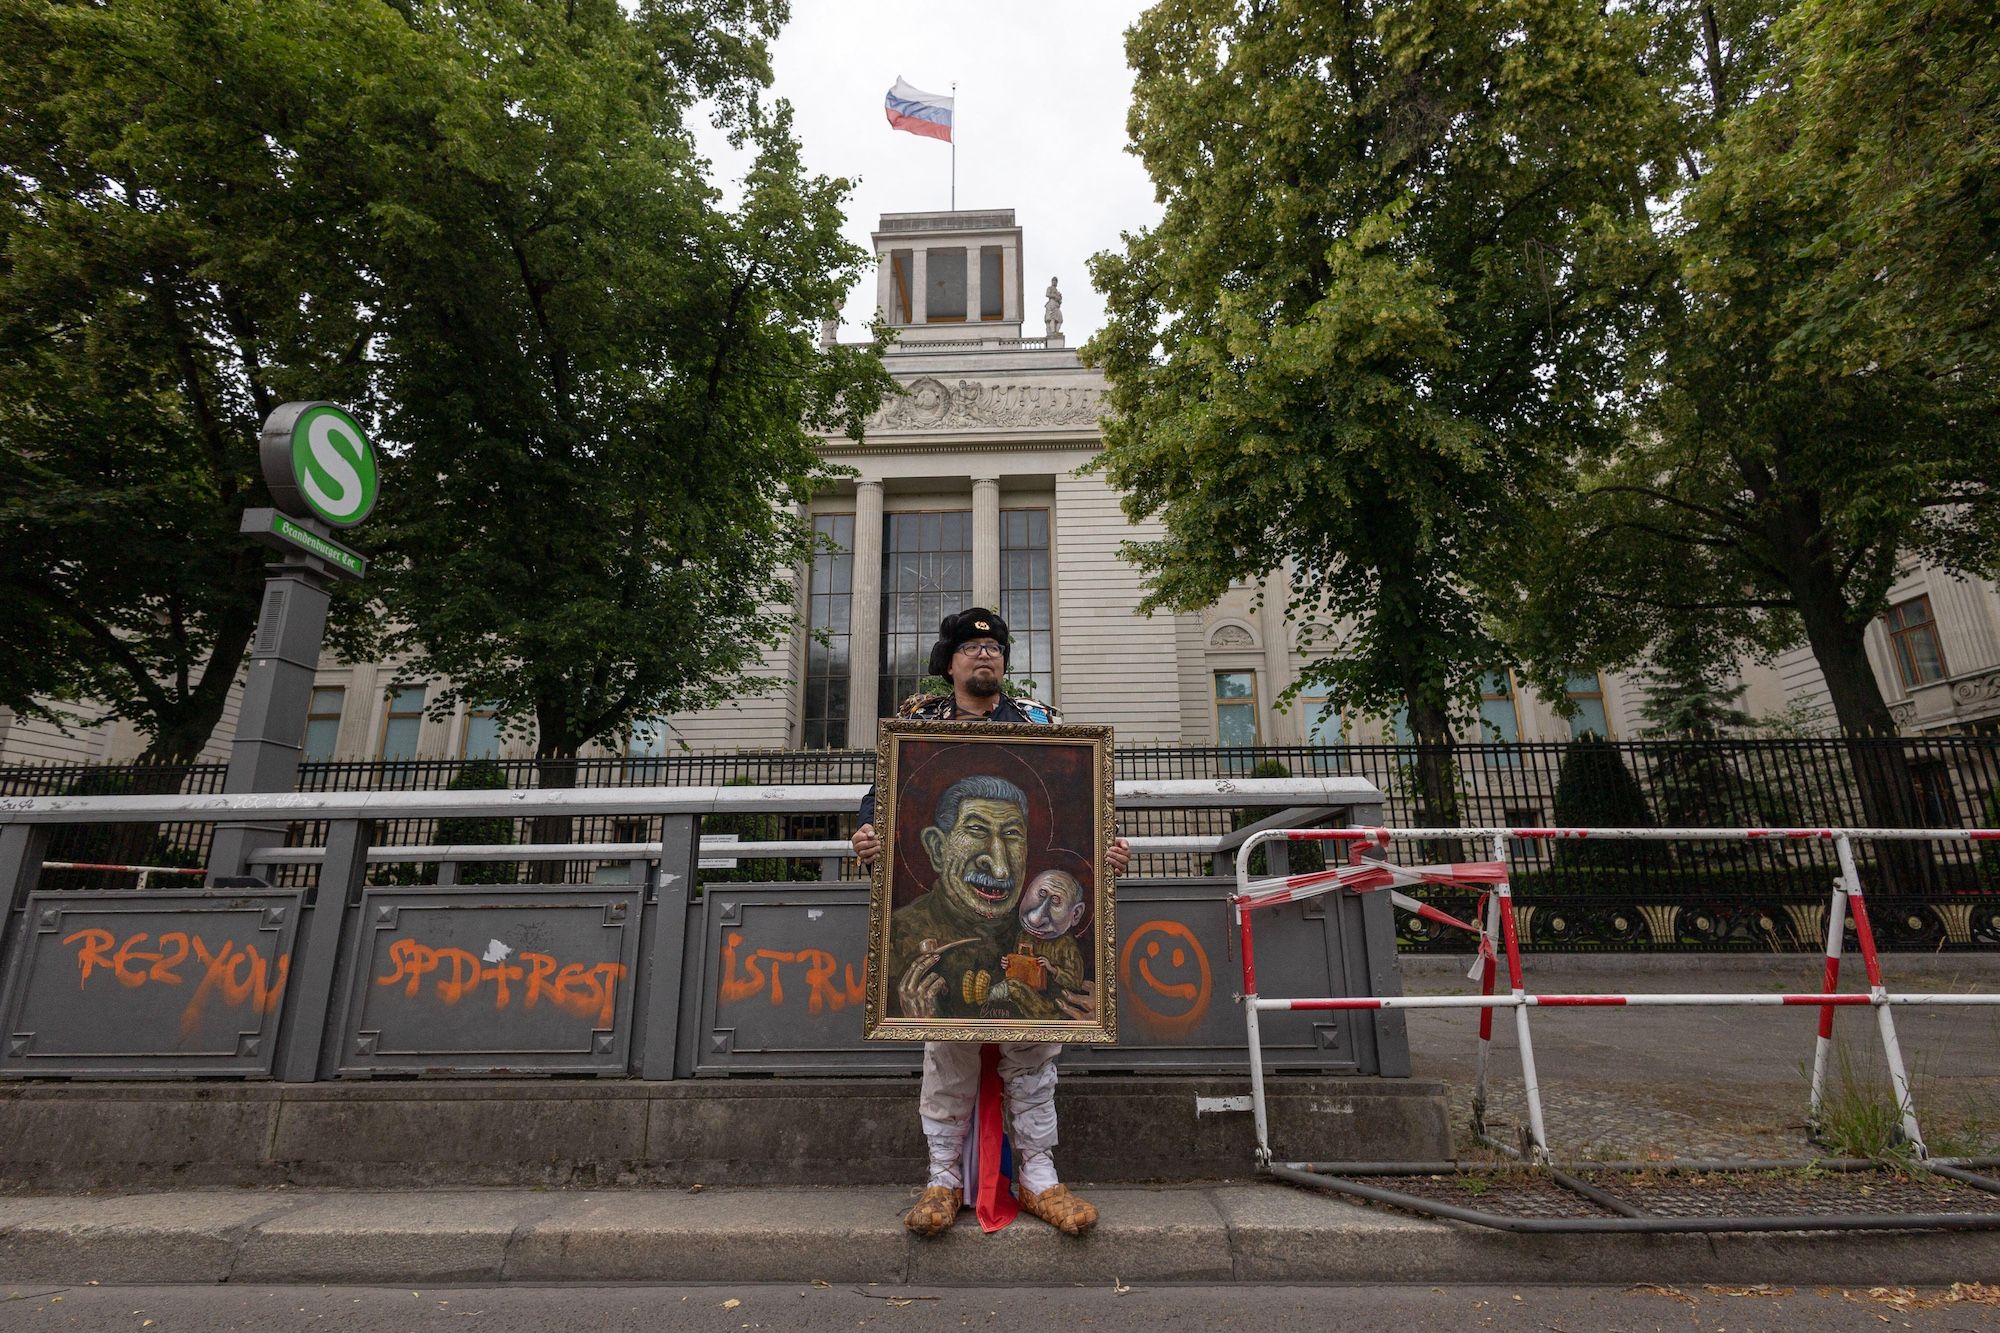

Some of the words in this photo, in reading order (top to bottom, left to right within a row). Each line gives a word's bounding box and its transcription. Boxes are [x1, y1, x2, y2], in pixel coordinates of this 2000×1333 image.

[303, 414, 364, 517] S
[281, 521, 342, 561] Brandenburger
[341, 550, 356, 569] Tor
